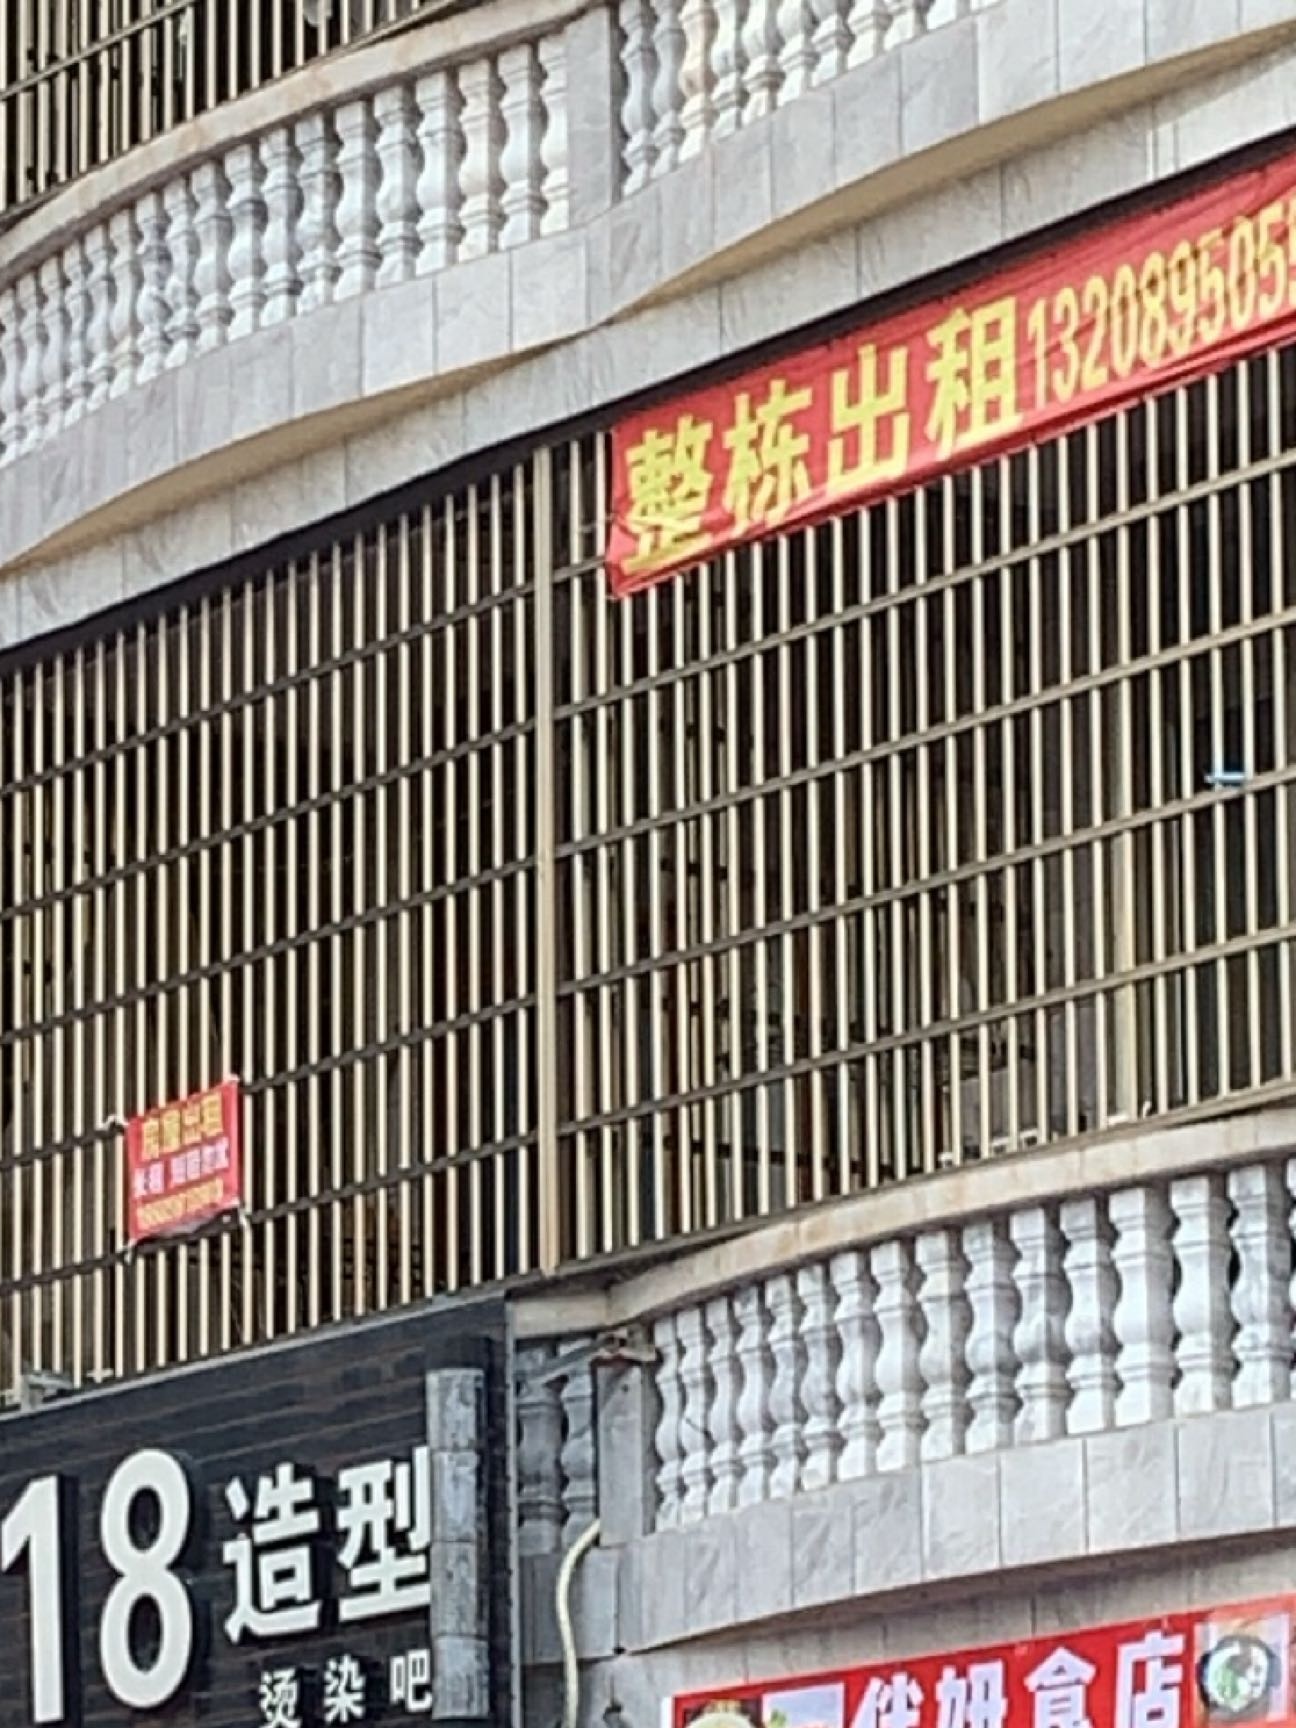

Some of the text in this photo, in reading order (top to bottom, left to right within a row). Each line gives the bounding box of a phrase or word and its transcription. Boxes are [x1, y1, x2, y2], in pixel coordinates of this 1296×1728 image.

[621, 190, 1296, 577] 整栋出租 132089505
[223, 1446, 432, 1644] 造型
